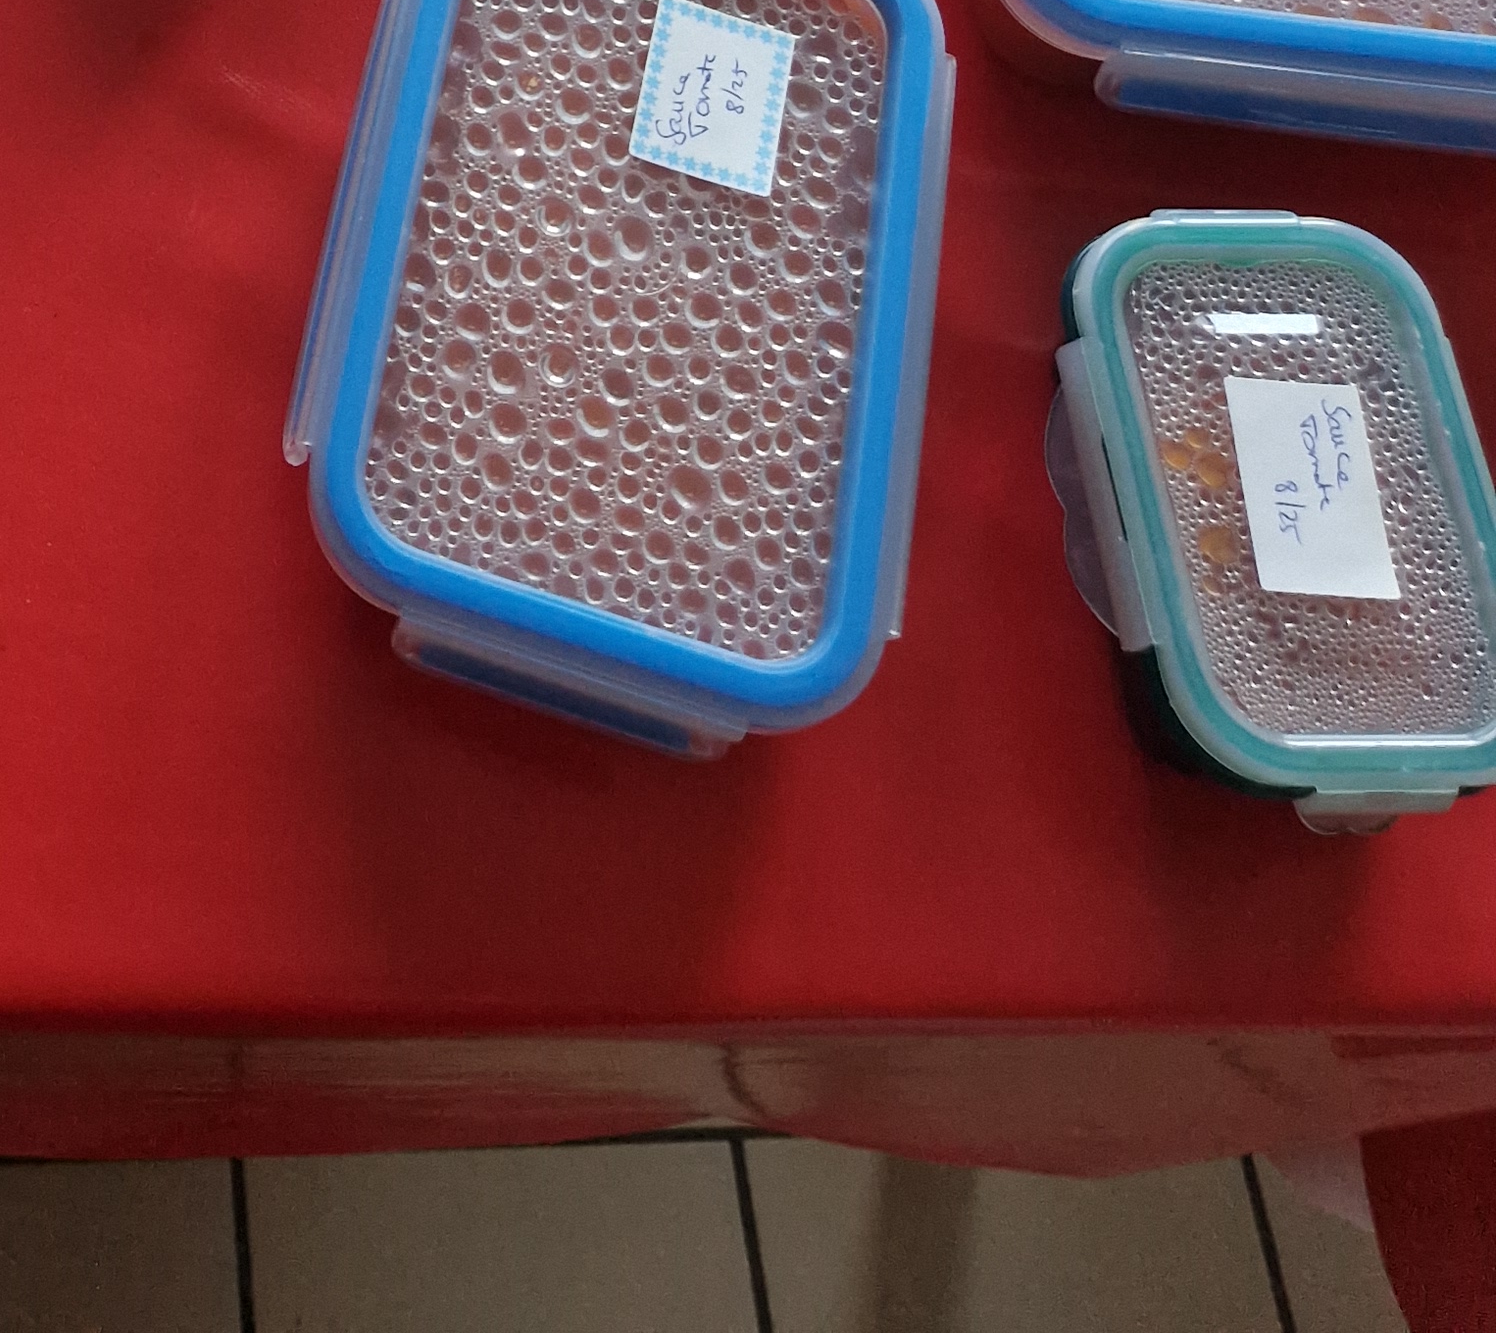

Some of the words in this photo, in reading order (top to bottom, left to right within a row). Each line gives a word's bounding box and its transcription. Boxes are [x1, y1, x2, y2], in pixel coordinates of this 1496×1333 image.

[655, 72, 691, 146] Sauce
[687, 53, 717, 138] Tomate
[719, 58, 748, 115] 8/25
[1299, 413, 1333, 512] Tomate
[1321, 398, 1353, 492] Sauce
[1274, 480, 1307, 546] 8/25
